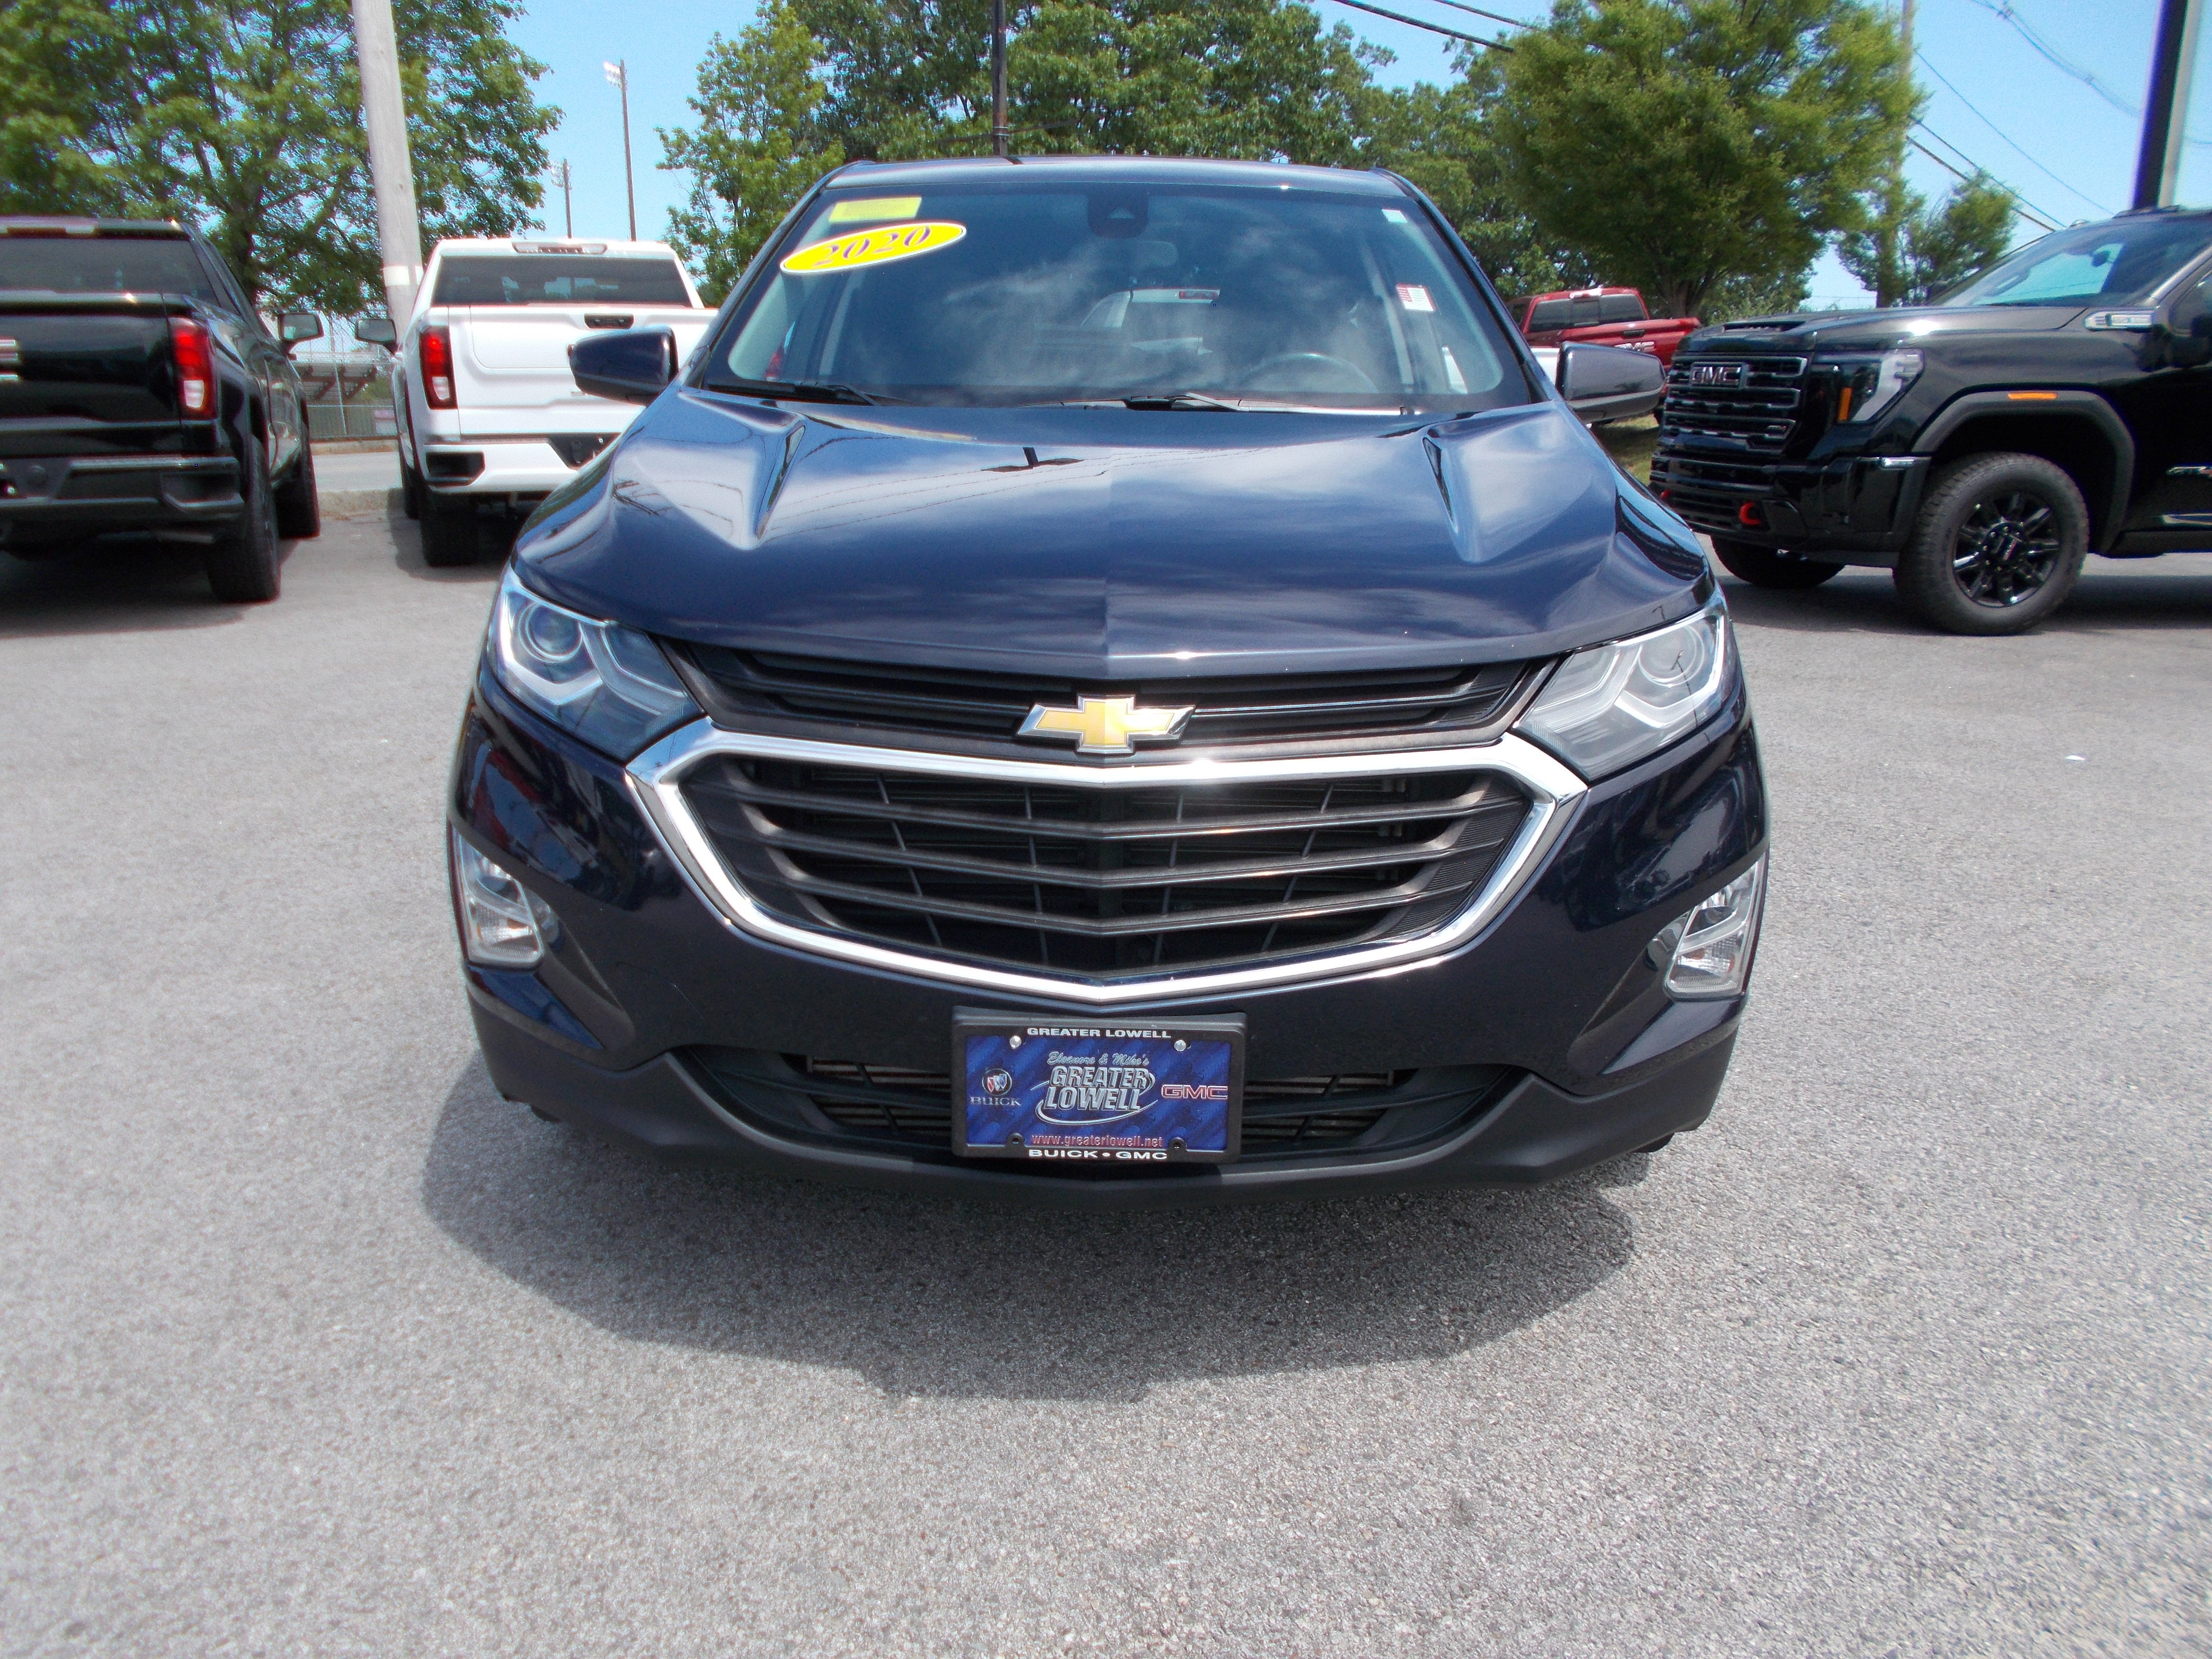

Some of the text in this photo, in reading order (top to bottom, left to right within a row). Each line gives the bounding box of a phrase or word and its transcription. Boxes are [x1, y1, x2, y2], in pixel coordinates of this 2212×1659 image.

[812, 226, 930, 266] 2020
[1692, 366, 1742, 385] GMC
[1027, 1028, 1171, 1038] GREATER LOWELL
[1047, 1051, 1150, 1066] Eleanore & Mike's
[1050, 1066, 1149, 1089] GREATER
[1043, 1087, 1141, 1111] LOWELL
[1161, 1084, 1228, 1099] GMC
[970, 1096, 1022, 1106] BUICK
[1031, 1135, 1164, 1148] www.greaterlowell.net
[1029, 1149, 1167, 1160] BUICK GMC
